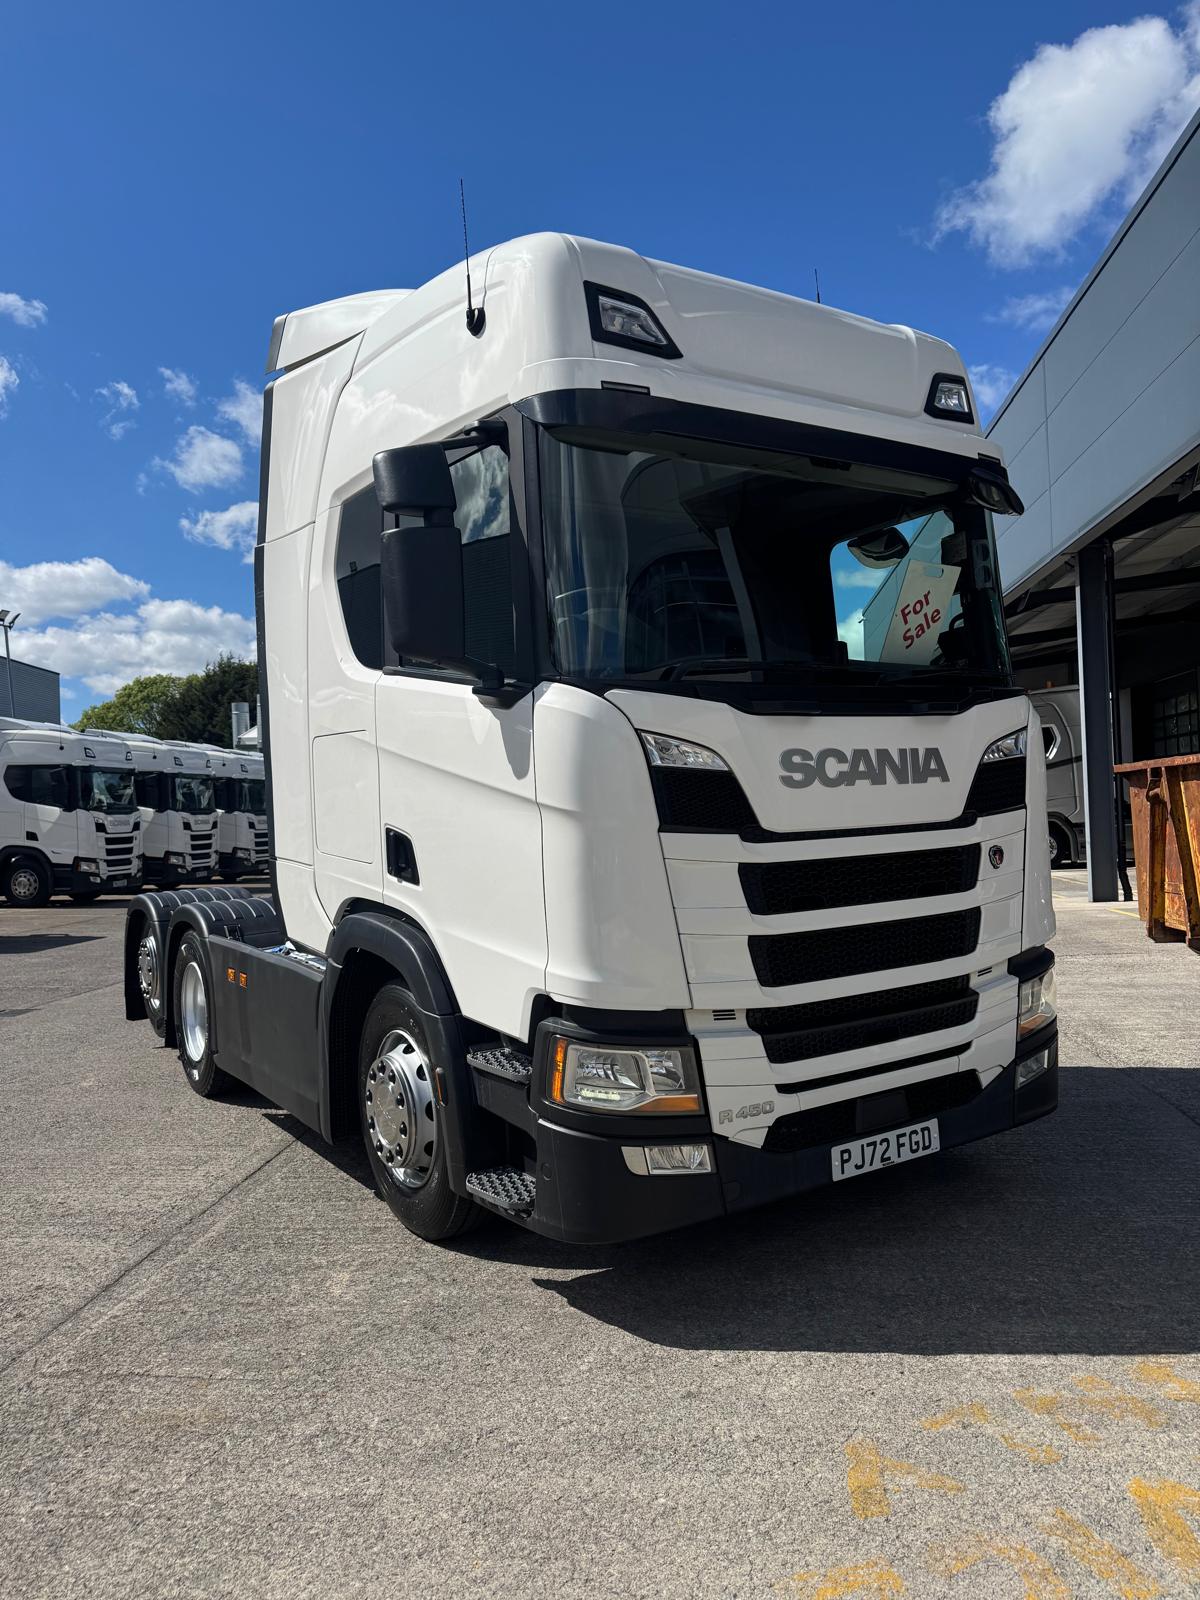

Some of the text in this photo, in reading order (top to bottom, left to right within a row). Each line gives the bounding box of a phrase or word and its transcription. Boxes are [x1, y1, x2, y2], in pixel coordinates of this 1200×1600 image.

[900, 590, 931, 625] For
[902, 608, 941, 649] Sale
[779, 747, 951, 789] SCANIA
[719, 1100, 775, 1125] R 450
[839, 1126, 932, 1175] PJ72 FGD
